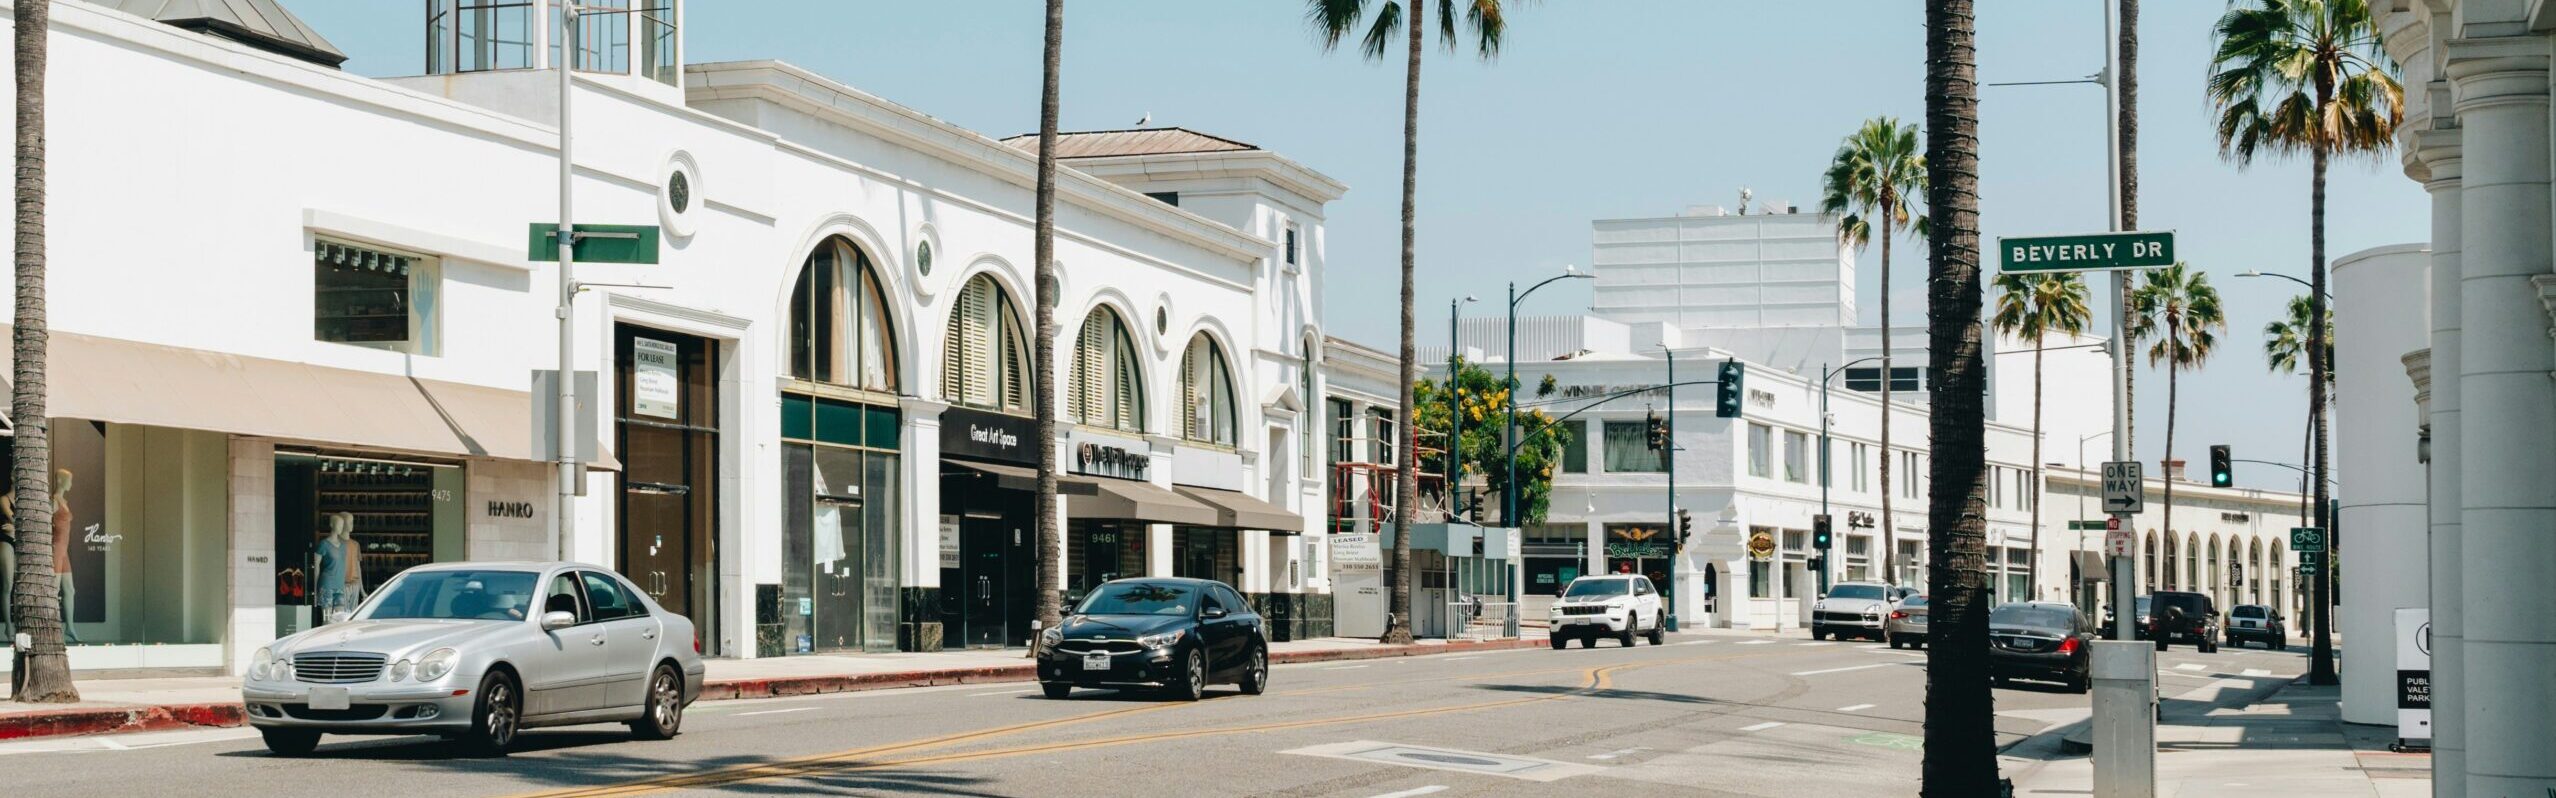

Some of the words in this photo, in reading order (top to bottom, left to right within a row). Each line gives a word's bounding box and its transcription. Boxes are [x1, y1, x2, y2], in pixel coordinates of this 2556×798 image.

[2013, 243, 2116, 262] BEVERLY
[2133, 241, 2163, 258] DR
[970, 424, 988, 442] Great
[989, 427, 999, 444] Art
[999, 427, 1017, 450] Space
[2106, 466, 2136, 478] ONE
[2106, 480, 2137, 492] WAY
[432, 489, 451, 501] 9475
[488, 500, 534, 519] HANRO
[2108, 520, 2118, 529] NO
[1092, 533, 1116, 543] 9461
